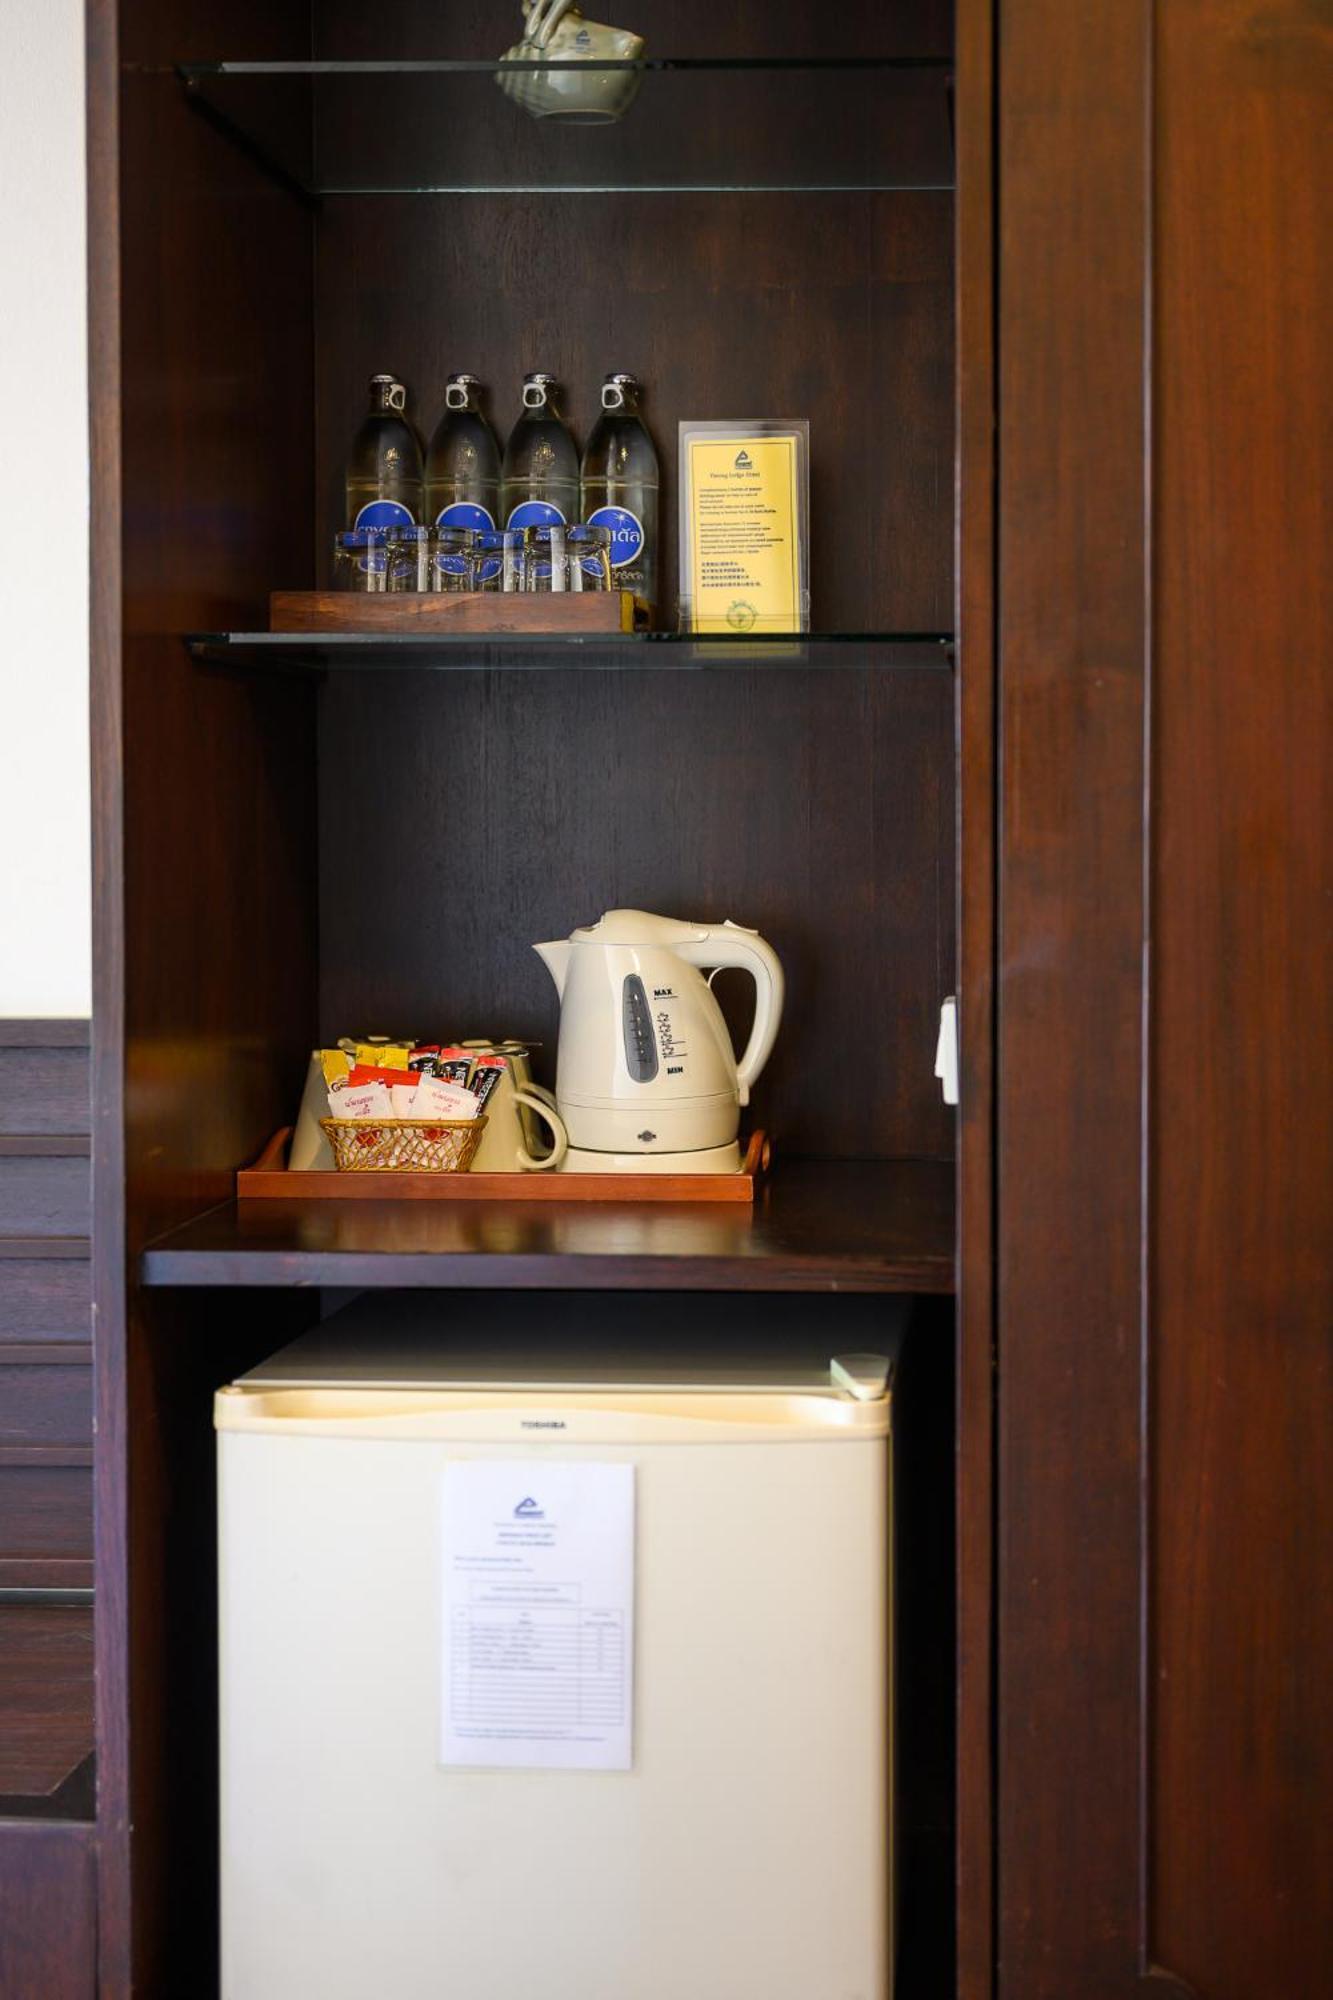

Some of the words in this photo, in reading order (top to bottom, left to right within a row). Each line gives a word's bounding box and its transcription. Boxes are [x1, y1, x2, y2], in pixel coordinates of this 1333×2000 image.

[653, 988, 673, 997] MAX
[667, 1066, 684, 1075] MIN
[520, 1420, 567, 1430] TOSHIBA
